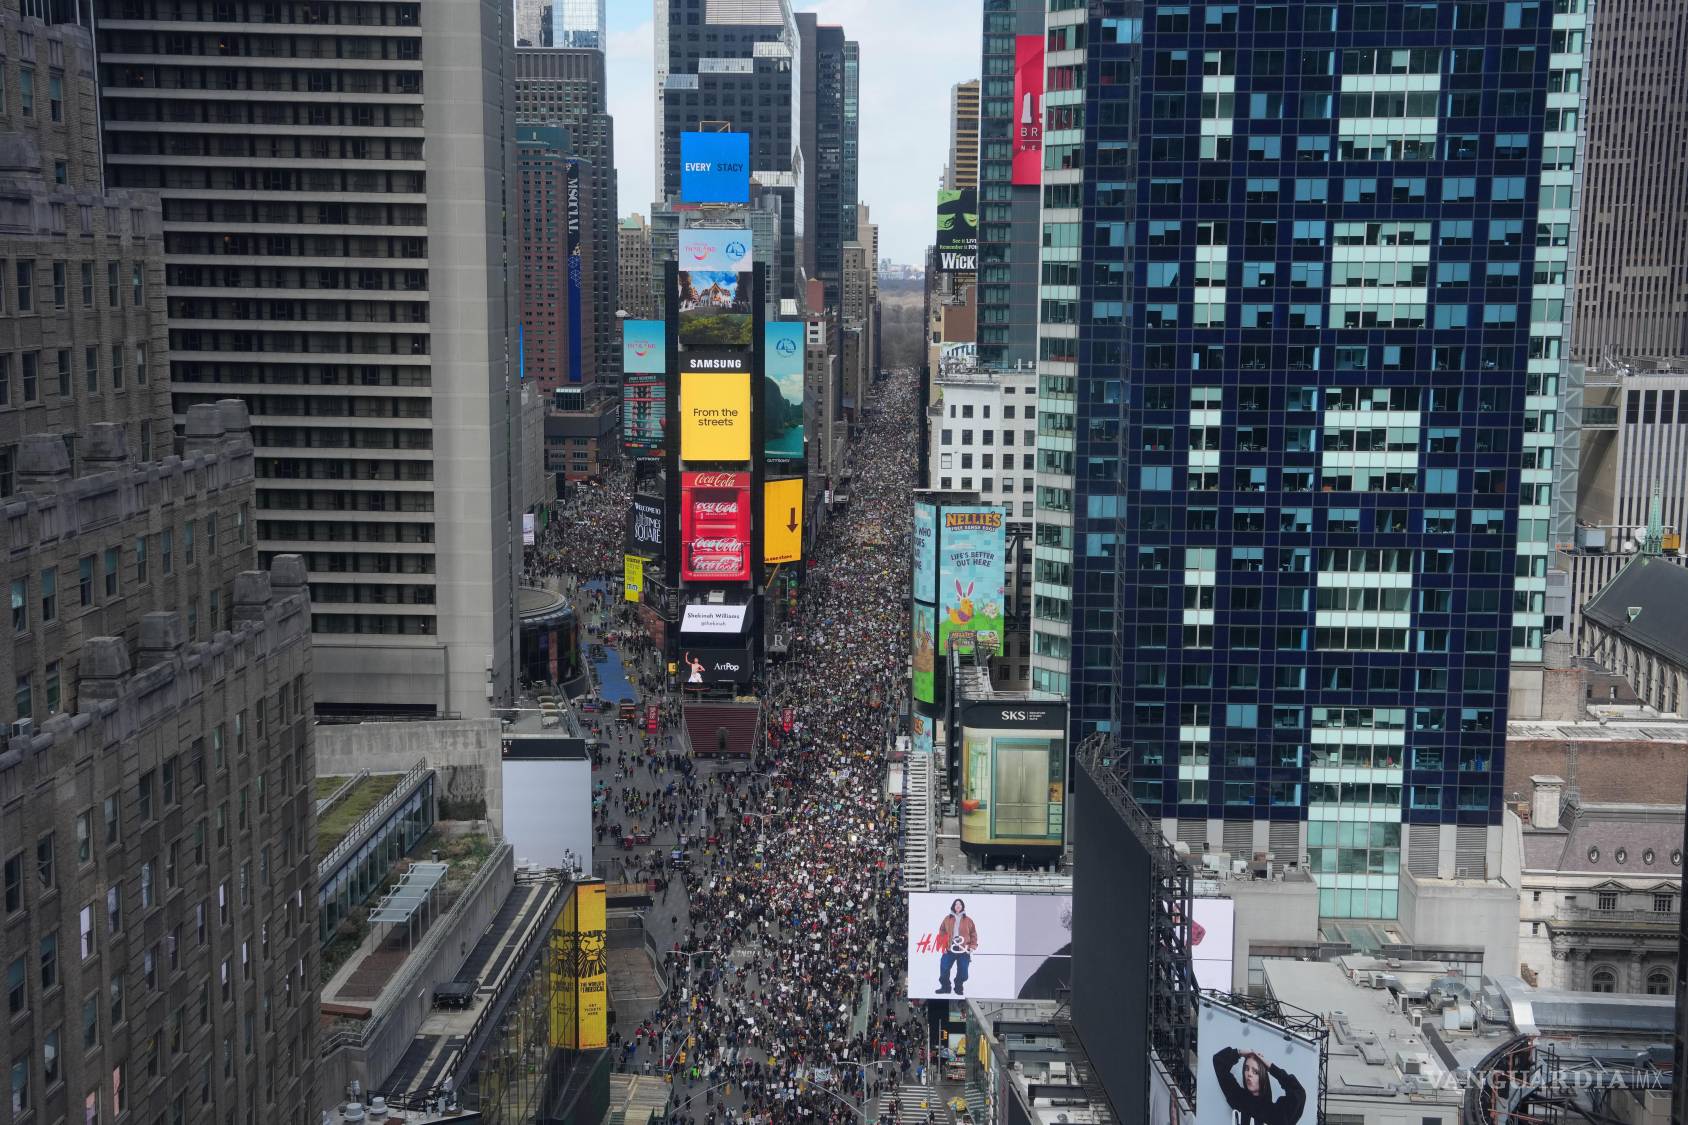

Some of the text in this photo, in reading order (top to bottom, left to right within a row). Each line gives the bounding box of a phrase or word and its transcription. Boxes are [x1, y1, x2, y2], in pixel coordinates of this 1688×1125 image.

[685, 163, 743, 173] EVERY STACY
[690, 359, 742, 369] SAMSUNG
[693, 408, 738, 417] From the
[698, 417, 734, 426] streets
[945, 511, 1003, 529] NELLIE'S
[714, 662, 740, 672] ArtPop
[1001, 710, 1026, 721] SKS
